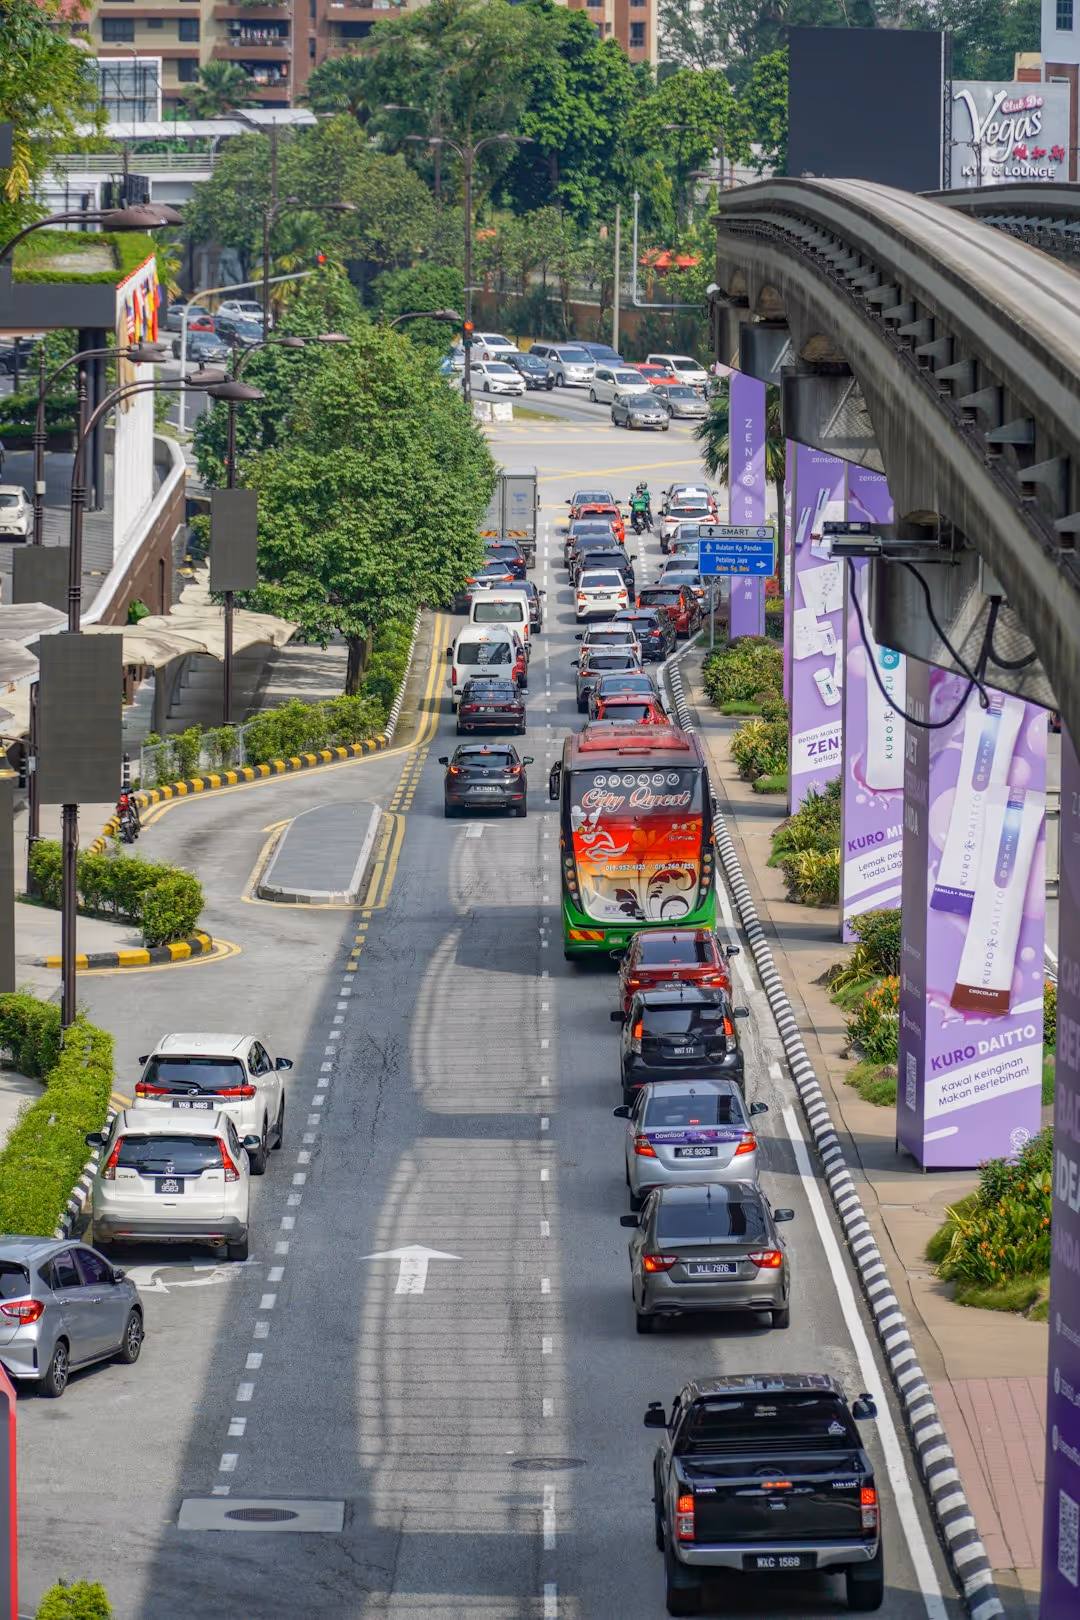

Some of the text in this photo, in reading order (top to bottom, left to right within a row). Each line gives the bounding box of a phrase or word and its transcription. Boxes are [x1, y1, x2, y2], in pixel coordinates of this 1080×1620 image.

[1002, 100, 1025, 113] Club
[953, 89, 1042, 163] Vegas
[992, 166, 1001, 177] &
[1005, 166, 1056, 177] LOUNGE
[721, 528, 750, 536] SMART
[743, 544, 762, 552] Pandan
[715, 556, 748, 565] Petaling Jaya
[798, 733, 819, 745] Bebas
[885, 726, 894, 760] KURO
[813, 752, 839, 764] Setiap
[581, 785, 692, 813] City Quest
[848, 831, 884, 852] KURO
[858, 856, 886, 872] Lemak
[862, 866, 886, 880] Tiada
[981, 951, 995, 986] KURO
[968, 987, 999, 998] CHOCOLATE
[931, 1025, 1036, 1071] KURO DAITTO
[941, 1057, 1024, 1093] Kawal Keinginan
[938, 1066, 1030, 1107] Makan Berlebihan!
[717, 1131, 735, 1140] today
[696, 1264, 710, 1273] VLL
[756, 1555, 800, 1568] WXC 1568
